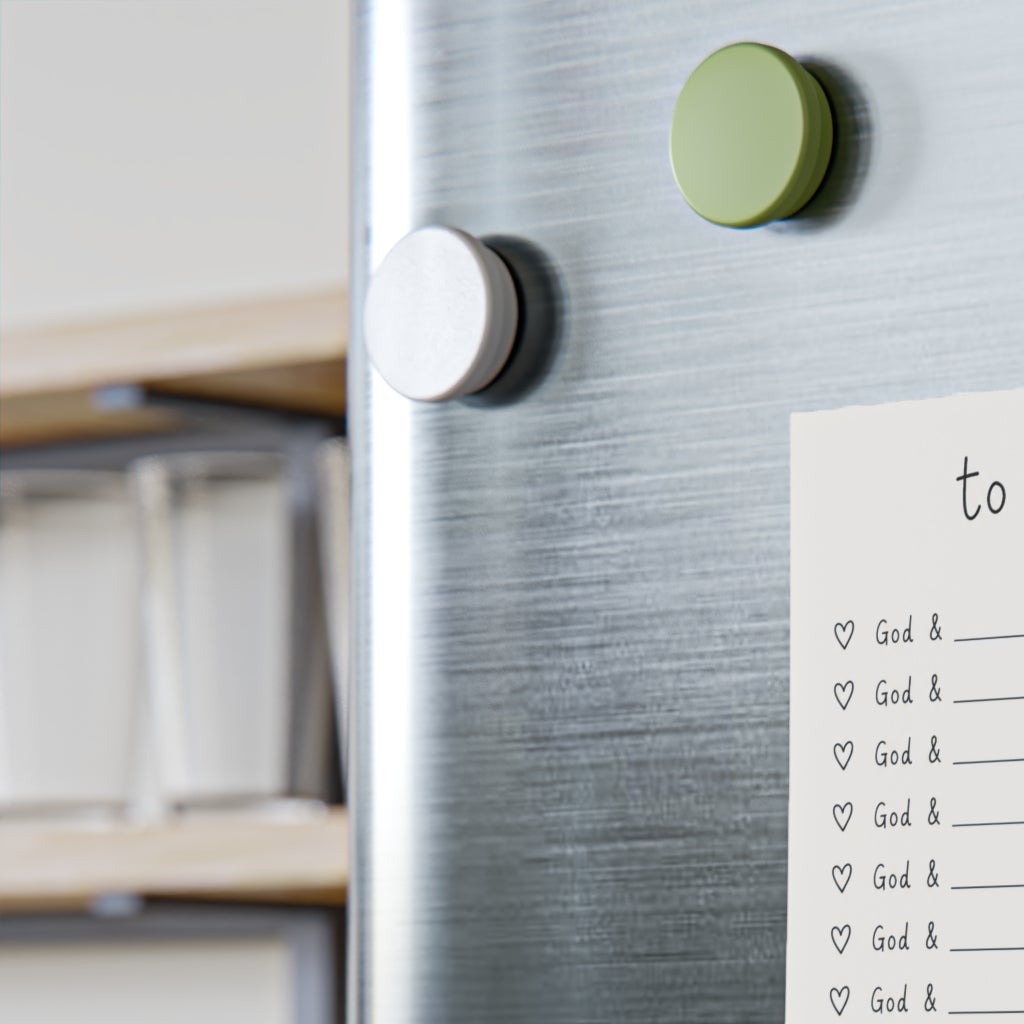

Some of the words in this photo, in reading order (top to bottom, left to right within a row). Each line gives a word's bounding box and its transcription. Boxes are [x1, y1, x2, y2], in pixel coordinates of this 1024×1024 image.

[956, 456, 1006, 521] to
[876, 615, 913, 646] God
[930, 613, 942, 641] &
[876, 676, 913, 706] God
[929, 674, 942, 702] &
[875, 736, 912, 767] God
[929, 735, 941, 763] &
[874, 798, 911, 829] God
[928, 797, 940, 825] &
[874, 860, 911, 890] God
[927, 859, 939, 887] &
[872, 922, 909, 952] God
[926, 921, 938, 949] &
[871, 984, 908, 1014] God
[924, 983, 936, 1012] &
